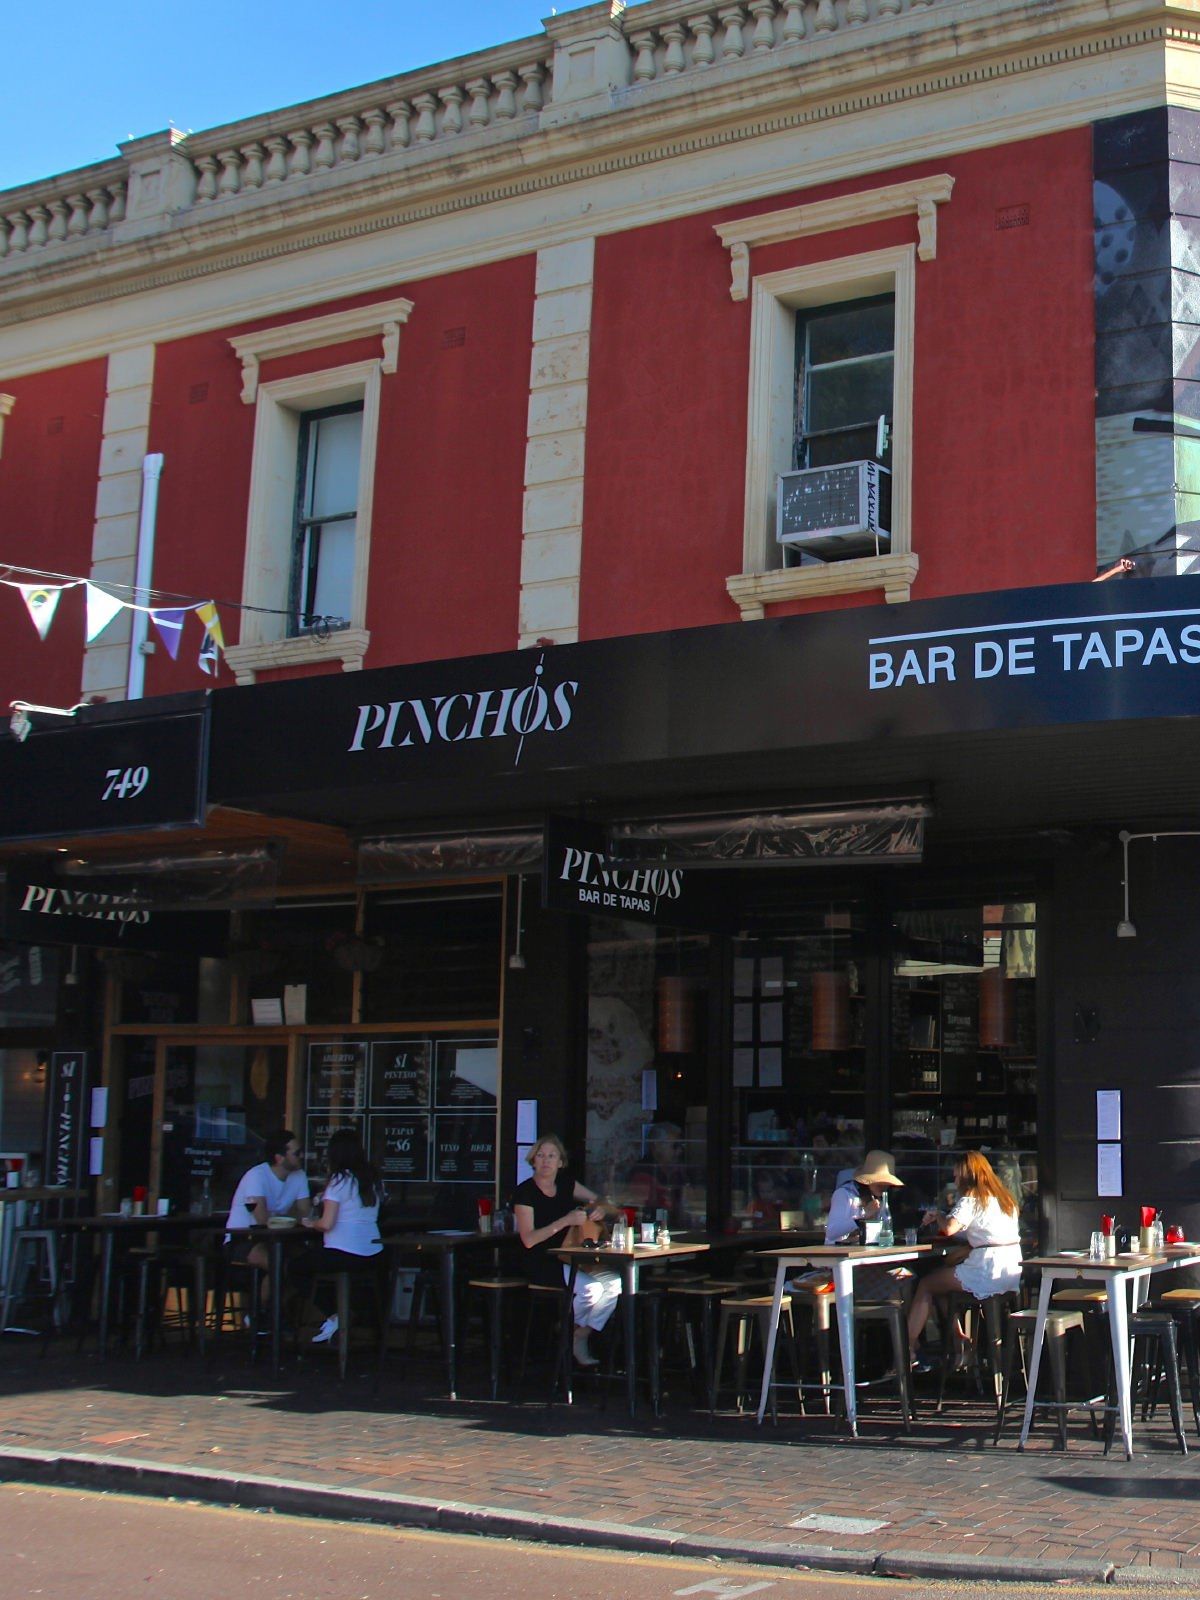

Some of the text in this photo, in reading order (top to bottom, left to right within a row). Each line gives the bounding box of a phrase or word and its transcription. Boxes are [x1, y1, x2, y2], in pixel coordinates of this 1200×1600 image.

[869, 645, 956, 690] BAR
[974, 637, 1036, 680] DE
[348, 680, 579, 752] PINCHOS
[101, 766, 149, 801] 749
[579, 888, 651, 912] BAR DE TAPAS
